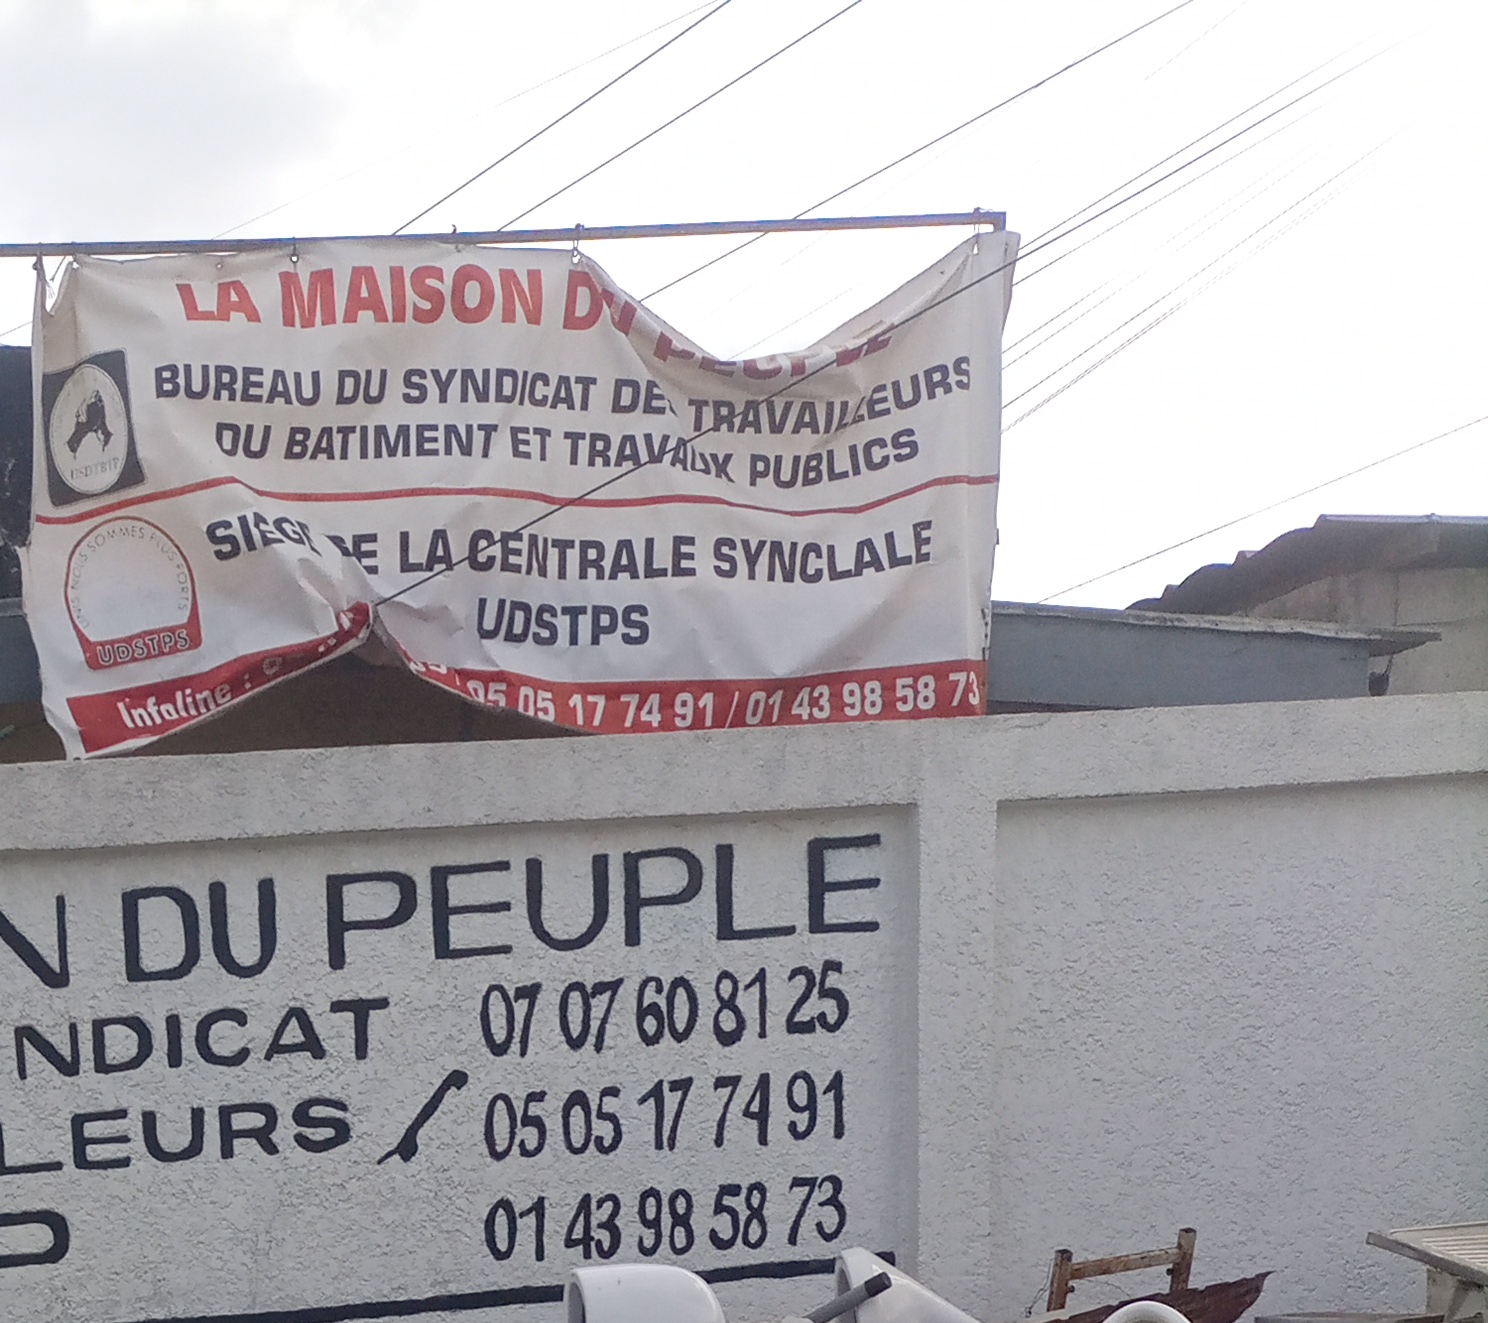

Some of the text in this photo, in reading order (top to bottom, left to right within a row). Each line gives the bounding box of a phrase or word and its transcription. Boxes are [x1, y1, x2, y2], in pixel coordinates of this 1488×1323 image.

[176, 280, 261, 323] LA
[278, 264, 543, 329] MAISON
[154, 364, 320, 405] BUREAU
[336, 369, 388, 405] DU
[402, 368, 597, 411] SYNDICAT
[215, 422, 272, 459] DU
[284, 423, 498, 460] BATIMENT
[510, 425, 551, 462] ET
[749, 428, 919, 488] PUBLICS
[400, 529, 454, 572] LA
[468, 529, 696, 581] CENTRALE
[713, 520, 933, 583] SYNCLALE
[97, 629, 190, 665] UDSTPS
[476, 597, 650, 646] UDSTPS
[467, 679, 507, 708] 05
[518, 685, 555, 722] 05
[568, 694, 606, 726] 17
[620, 694, 661, 728] 74
[674, 692, 713, 727] 91
[745, 689, 784, 725] 01
[791, 686, 831, 721] 43
[844, 681, 883, 717] 98
[895, 676, 936, 711] 58
[949, 671, 981, 705] 73
[122, 879, 276, 982] DU
[326, 834, 881, 970] PEUPLE
[480, 960, 850, 1057] 07 07 60 81 25
[484, 1070, 845, 1161] 05 05 17 74 91
[484, 1175, 847, 1261] 01 43 98 58 73
